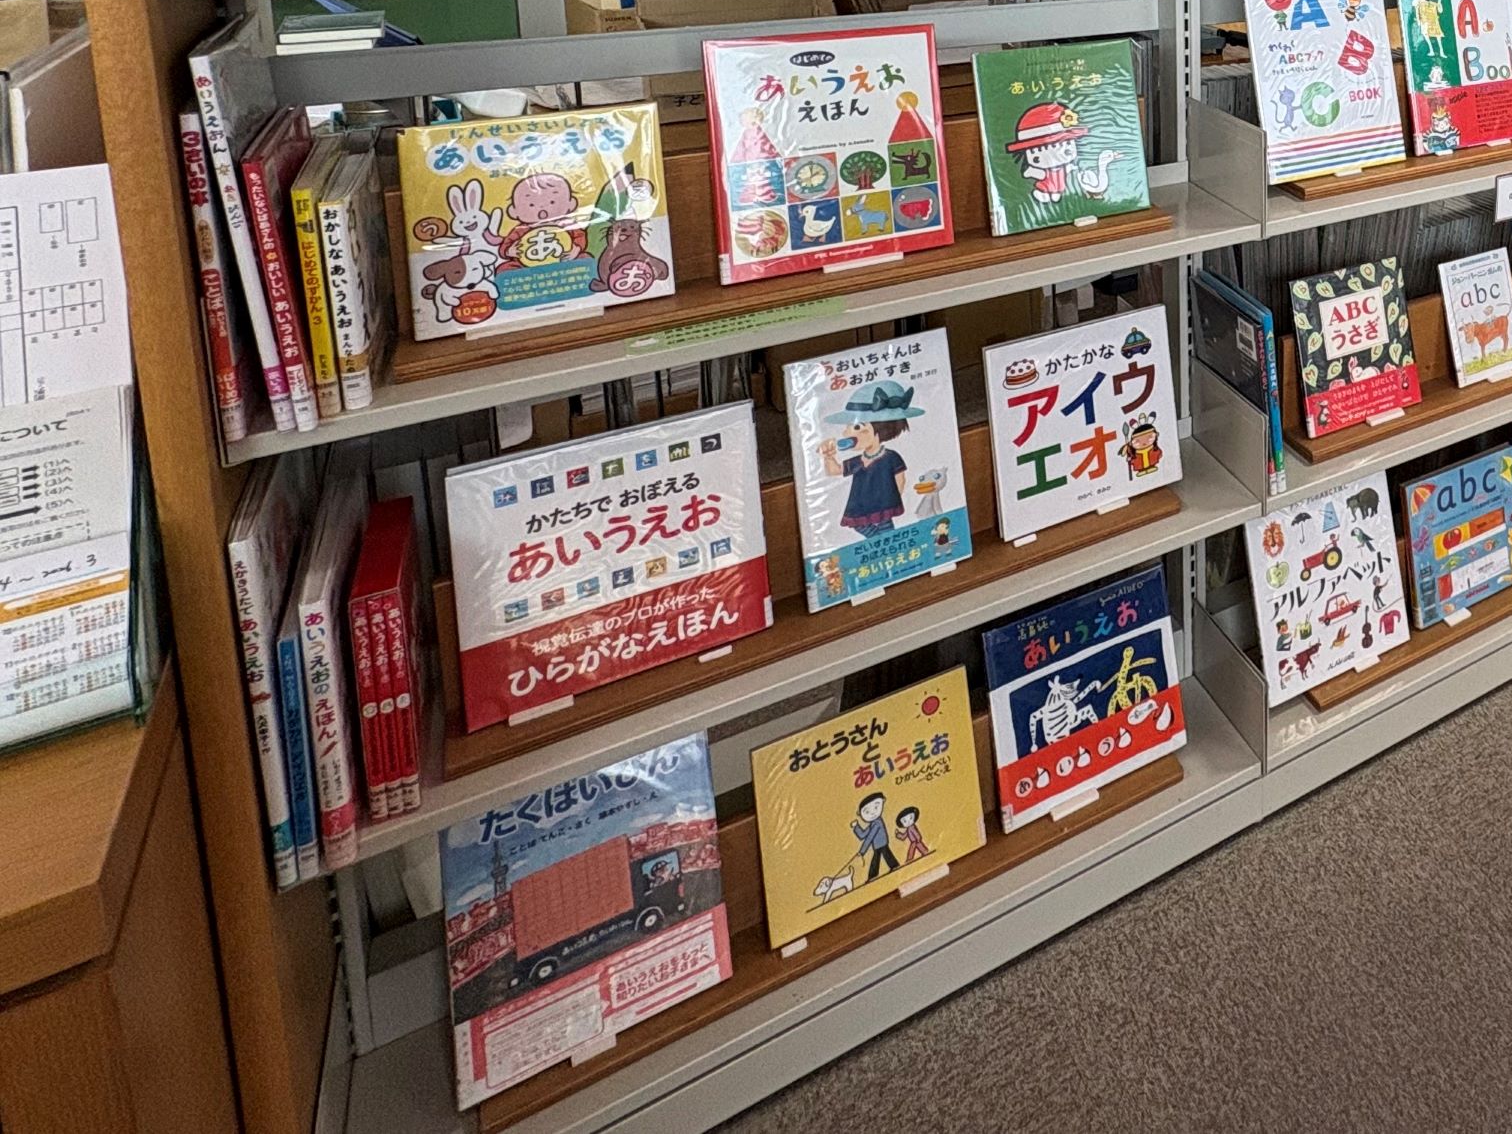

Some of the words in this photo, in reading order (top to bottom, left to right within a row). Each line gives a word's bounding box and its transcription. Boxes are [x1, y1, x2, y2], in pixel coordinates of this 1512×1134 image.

[1338, 29, 1375, 75] B
[755, 63, 905, 102] あいうえお
[1300, 81, 1340, 128] C
[1349, 87, 1382, 102] BOOK
[798, 99, 869, 123] えほん
[434, 129, 625, 172] あいうえお
[322, 208, 343, 259] おかしな
[526, 231, 564, 260] あ
[331, 265, 352, 329] あいうえお
[615, 266, 649, 291] お
[1460, 282, 1501, 308] abc
[275, 301, 299, 358] あいうえお
[1329, 296, 1378, 326] ABC
[1331, 317, 1380, 350] うさぎ
[830, 369, 878, 391] あおが
[884, 361, 911, 377] すき
[1045, 344, 1115, 376] かたかな
[1008, 361, 1156, 447] アイウ
[1016, 426, 1117, 501] エオ
[526, 494, 612, 534] かたちで
[619, 471, 700, 509] おぼえる
[1437, 466, 1497, 514] abc
[506, 493, 722, 585] あいうえお
[1268, 551, 1391, 619] アルファベット
[531, 584, 716, 657] 視覚伝達のプロが作った
[1024, 600, 1139, 670] あいうえお
[305, 612, 330, 695] あいうえおの
[508, 601, 739, 698] ひらがなえほん
[315, 699, 337, 742] えほん
[789, 718, 888, 773] おとうさん
[853, 733, 949, 788] あいうえお
[862, 741, 881, 762] と
[895, 756, 951, 785] ひがしくんぺい
